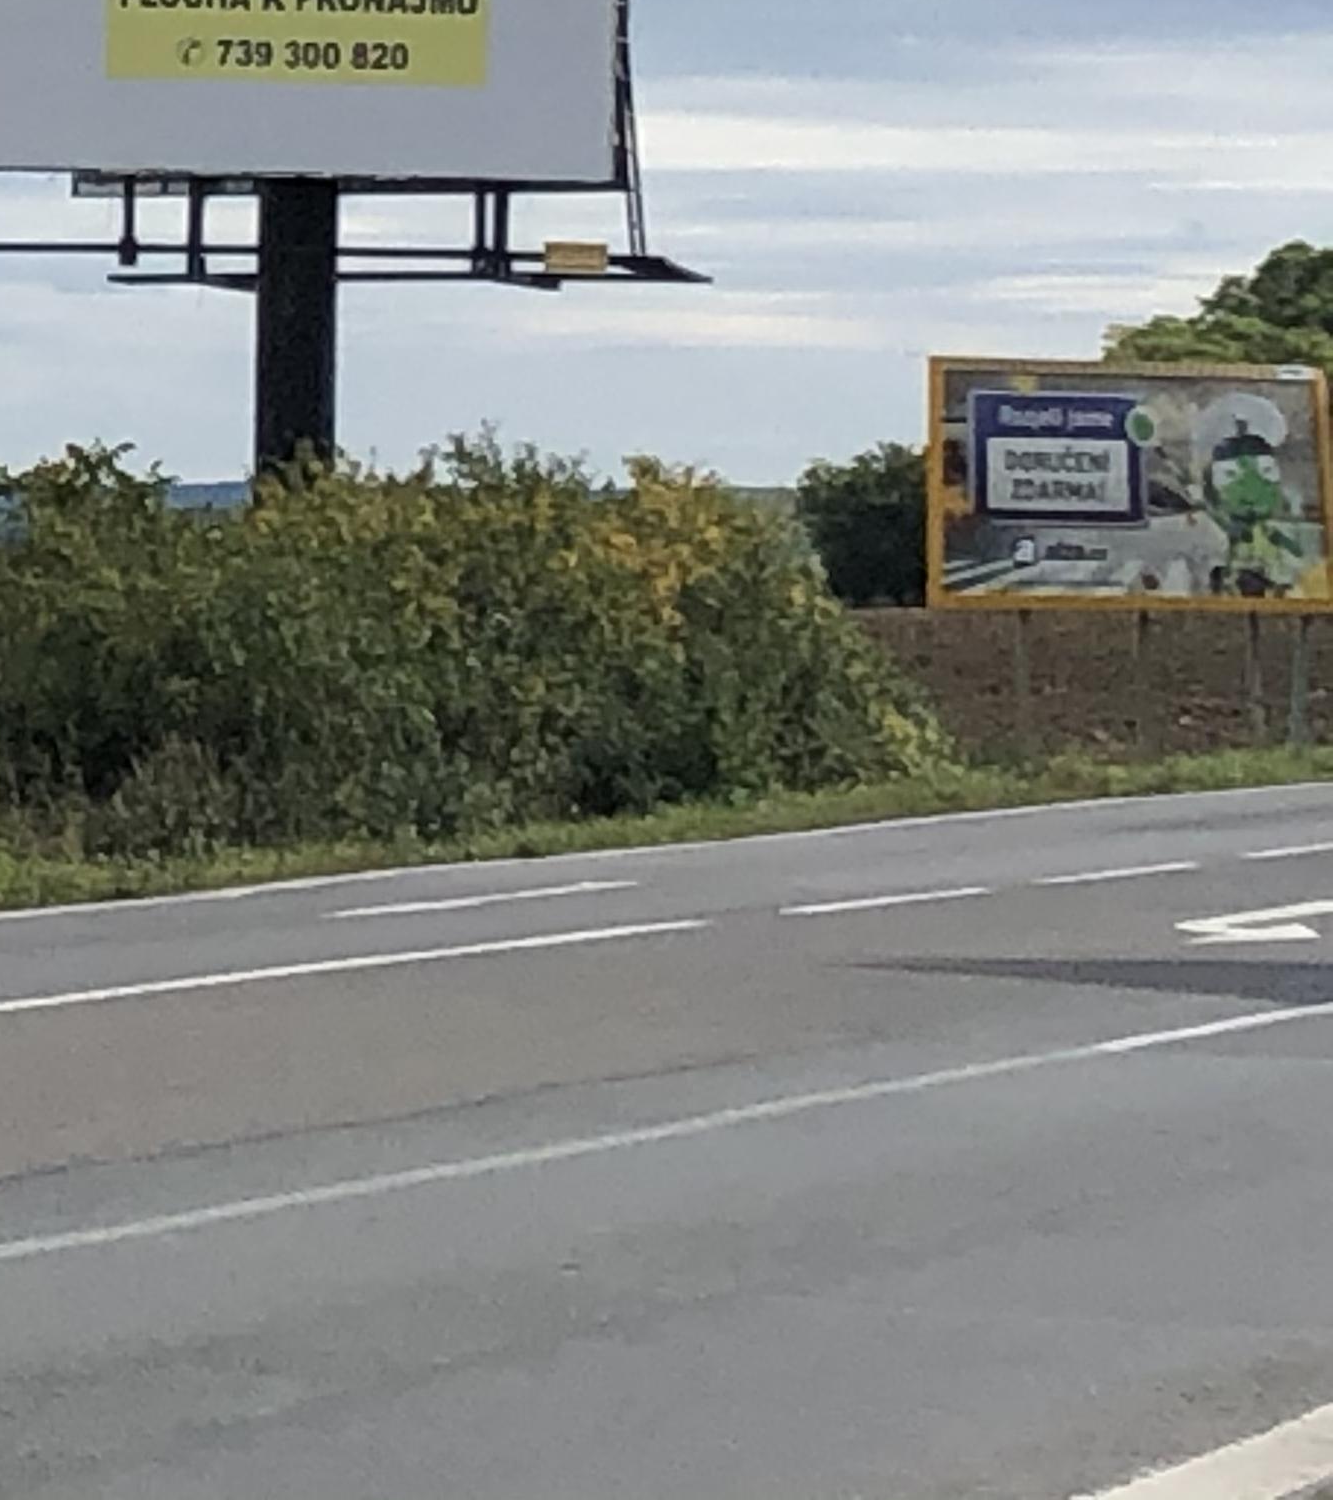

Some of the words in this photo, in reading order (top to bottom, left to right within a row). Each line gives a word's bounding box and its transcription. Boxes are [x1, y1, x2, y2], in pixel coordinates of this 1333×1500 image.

[217, 39, 273, 67] 739
[284, 41, 341, 69] 300
[350, 42, 410, 70] 820
